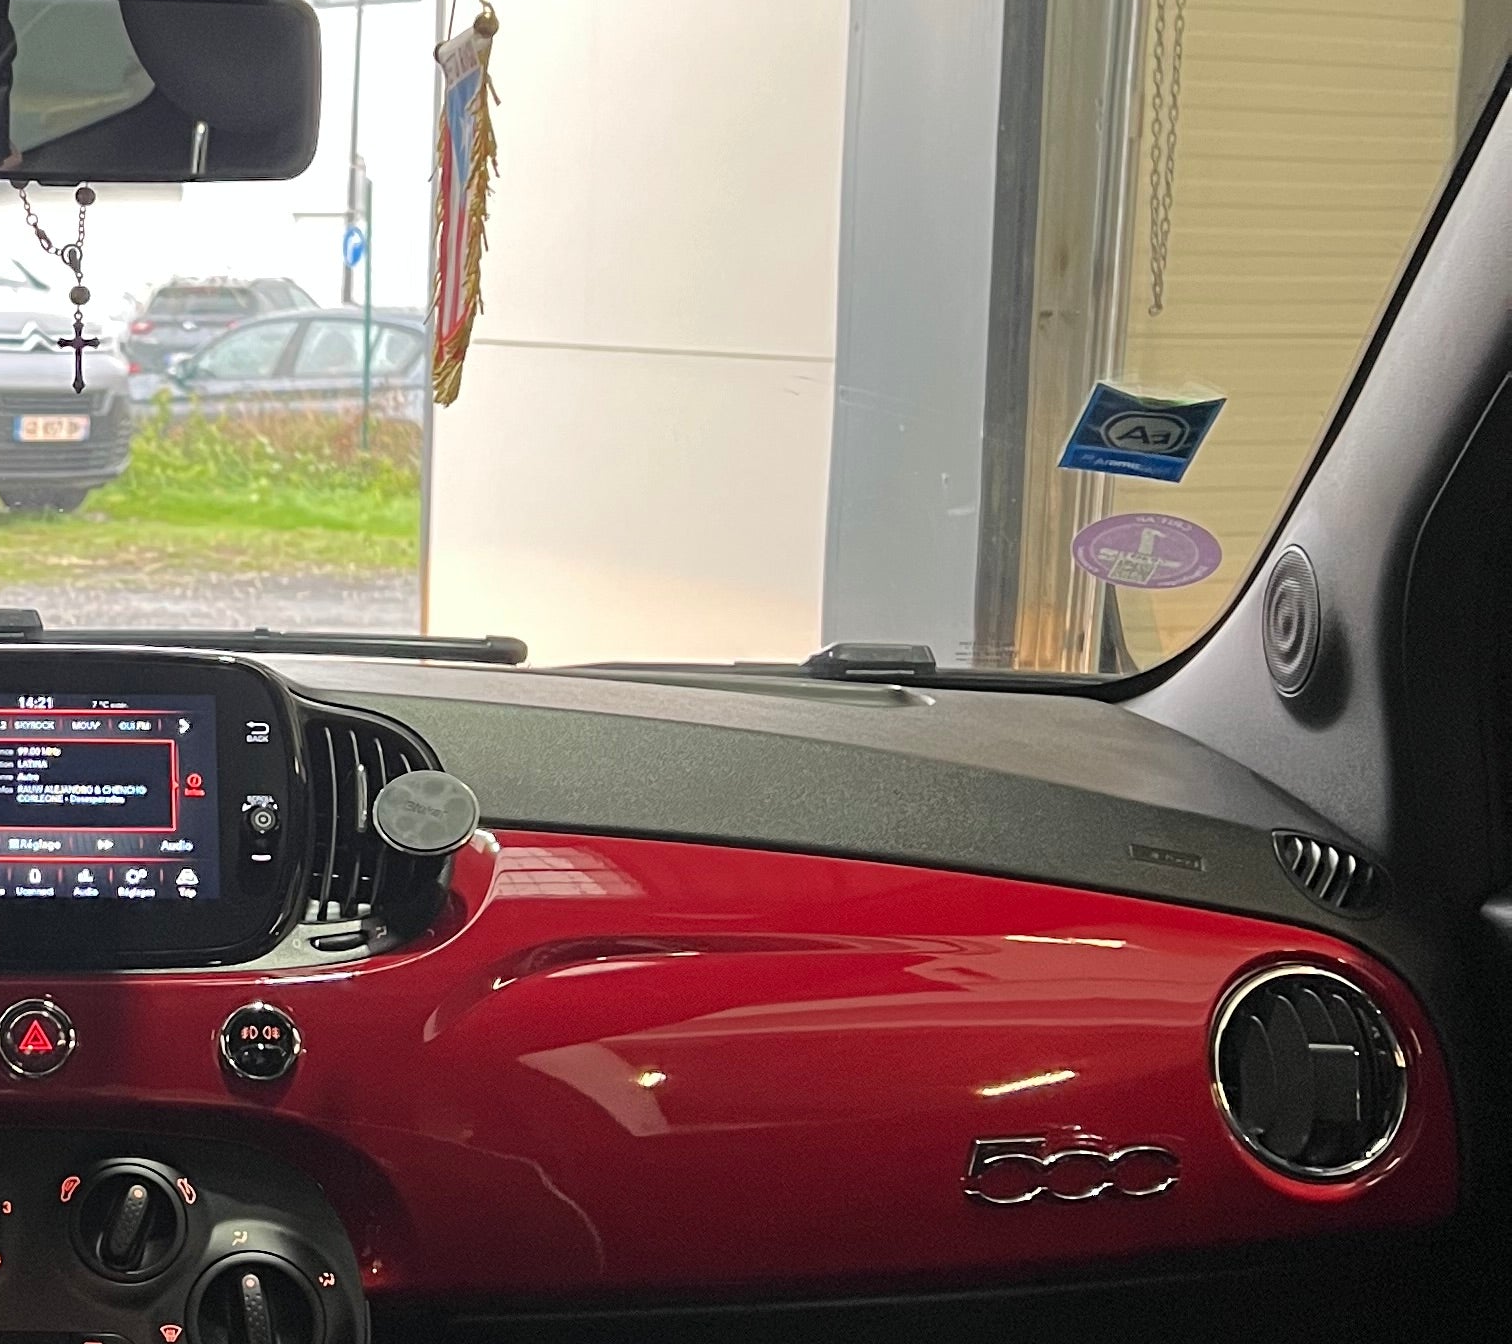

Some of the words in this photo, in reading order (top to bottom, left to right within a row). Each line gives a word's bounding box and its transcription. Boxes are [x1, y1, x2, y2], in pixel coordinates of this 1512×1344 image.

[18, 696, 54, 709] 14:21
[160, 840, 194, 852] Audio
[961, 1135, 1183, 1204] 500
[1, 1199, 13, 1215] 3
